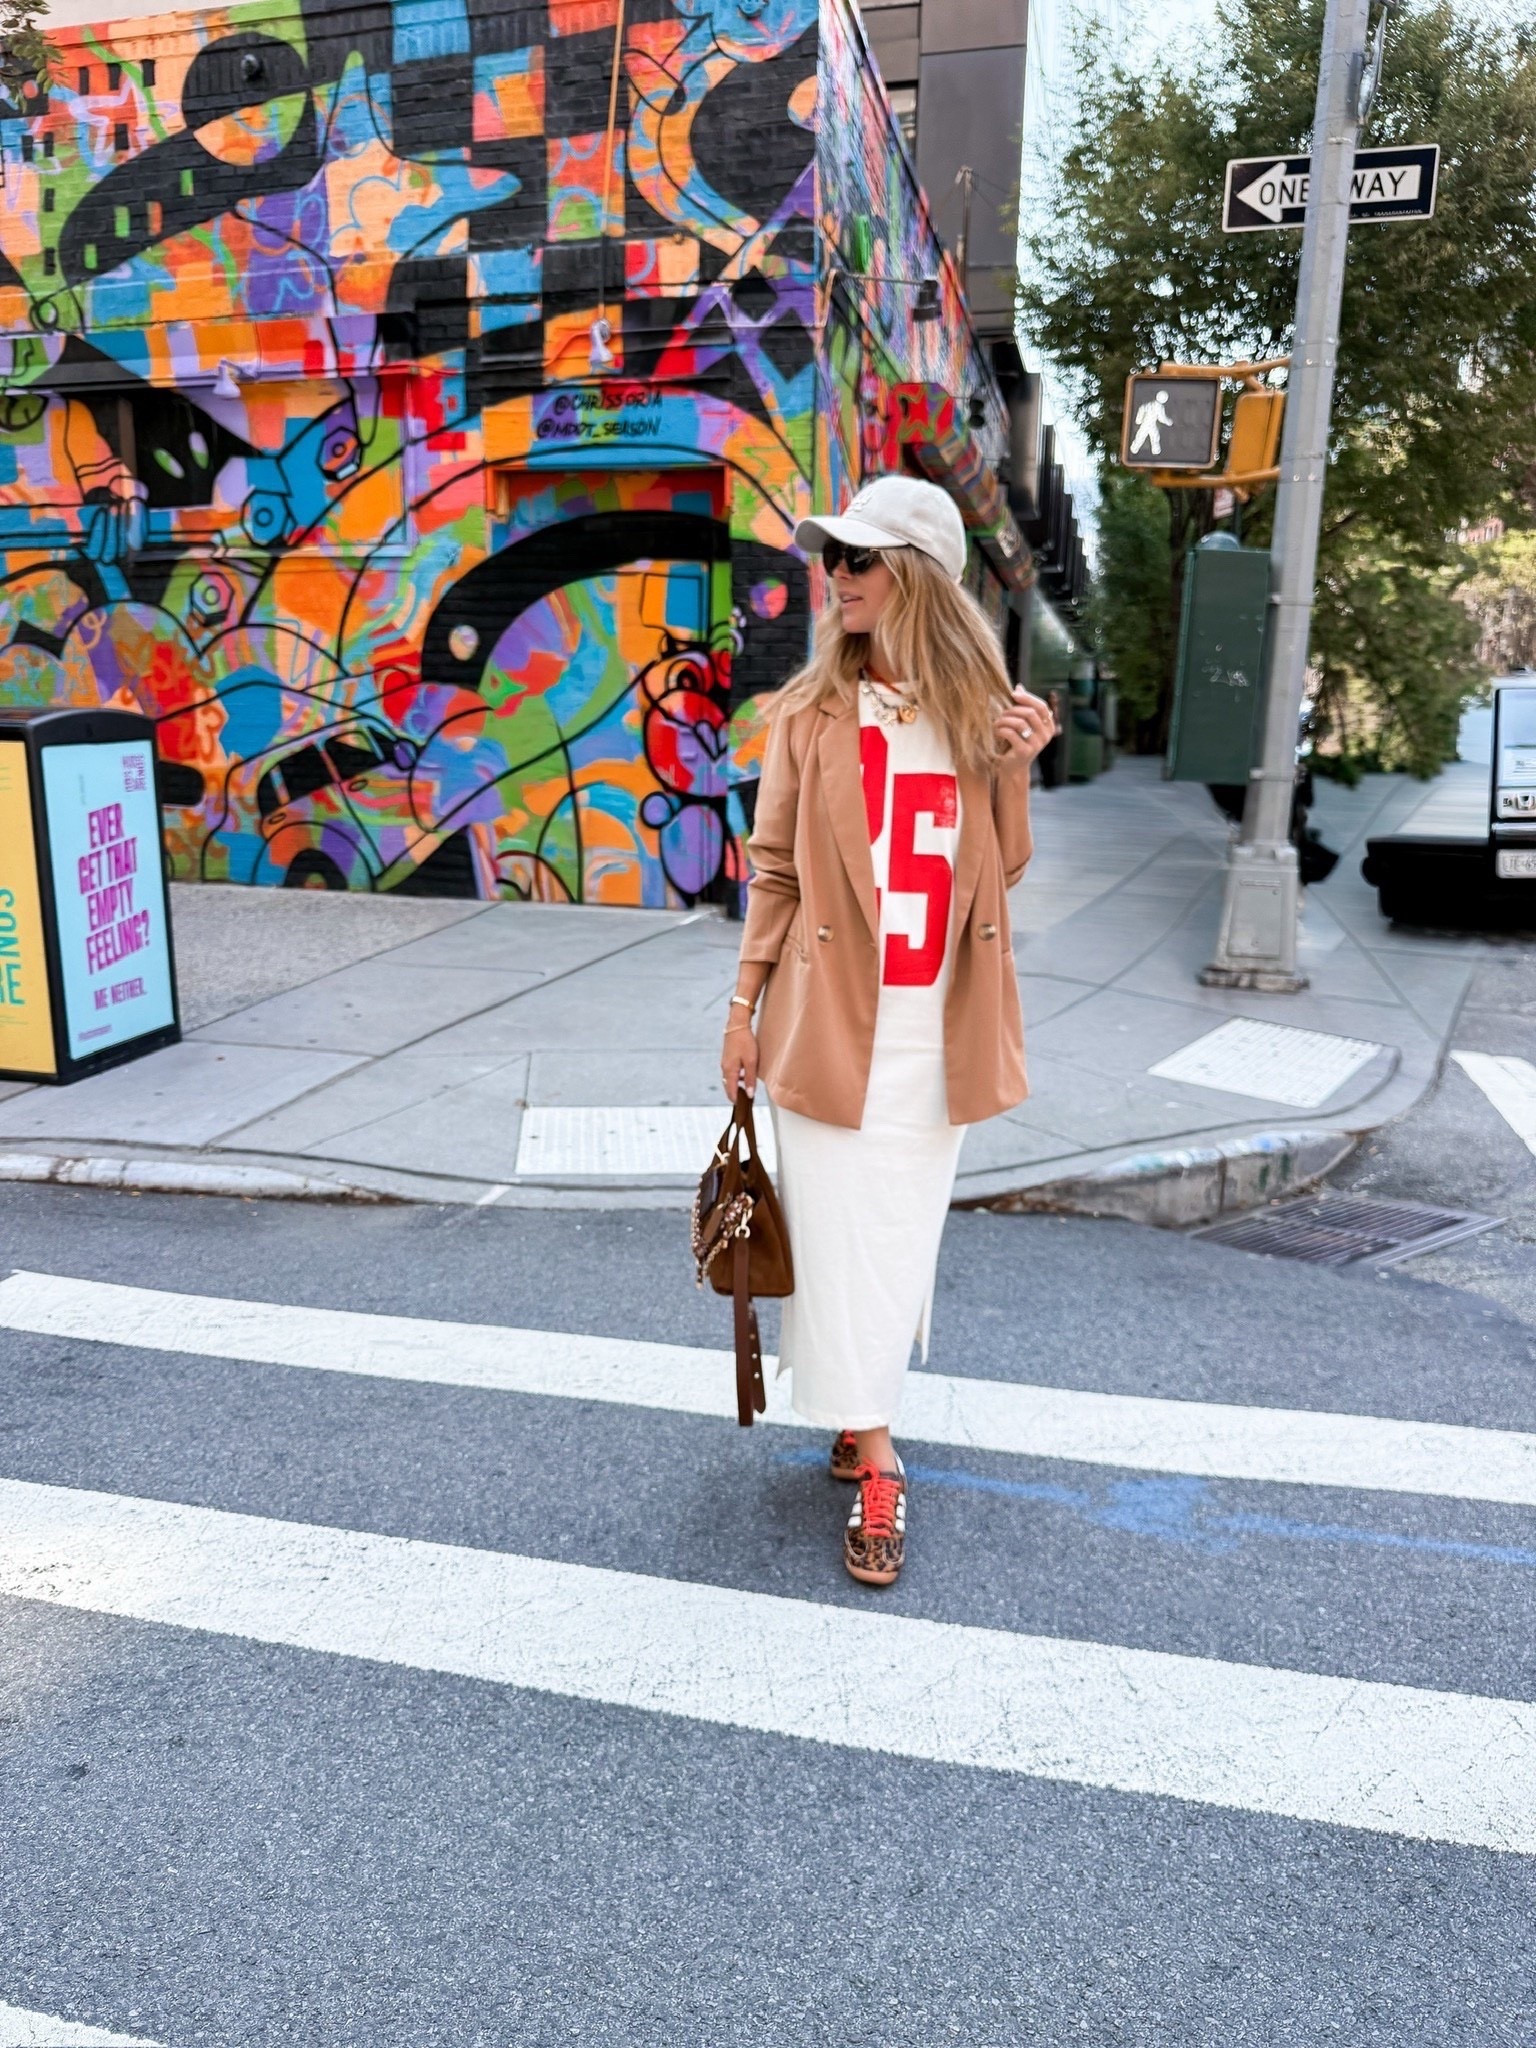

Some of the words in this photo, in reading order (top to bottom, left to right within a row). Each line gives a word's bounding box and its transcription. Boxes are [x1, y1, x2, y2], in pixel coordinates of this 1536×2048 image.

[1260, 178, 1309, 205] ONE
[88, 803, 124, 848] EVER
[78, 852, 102, 894] GET
[107, 837, 137, 882] THAT
[88, 878, 133, 931] EMPTY
[86, 909, 150, 975] FEELING?
